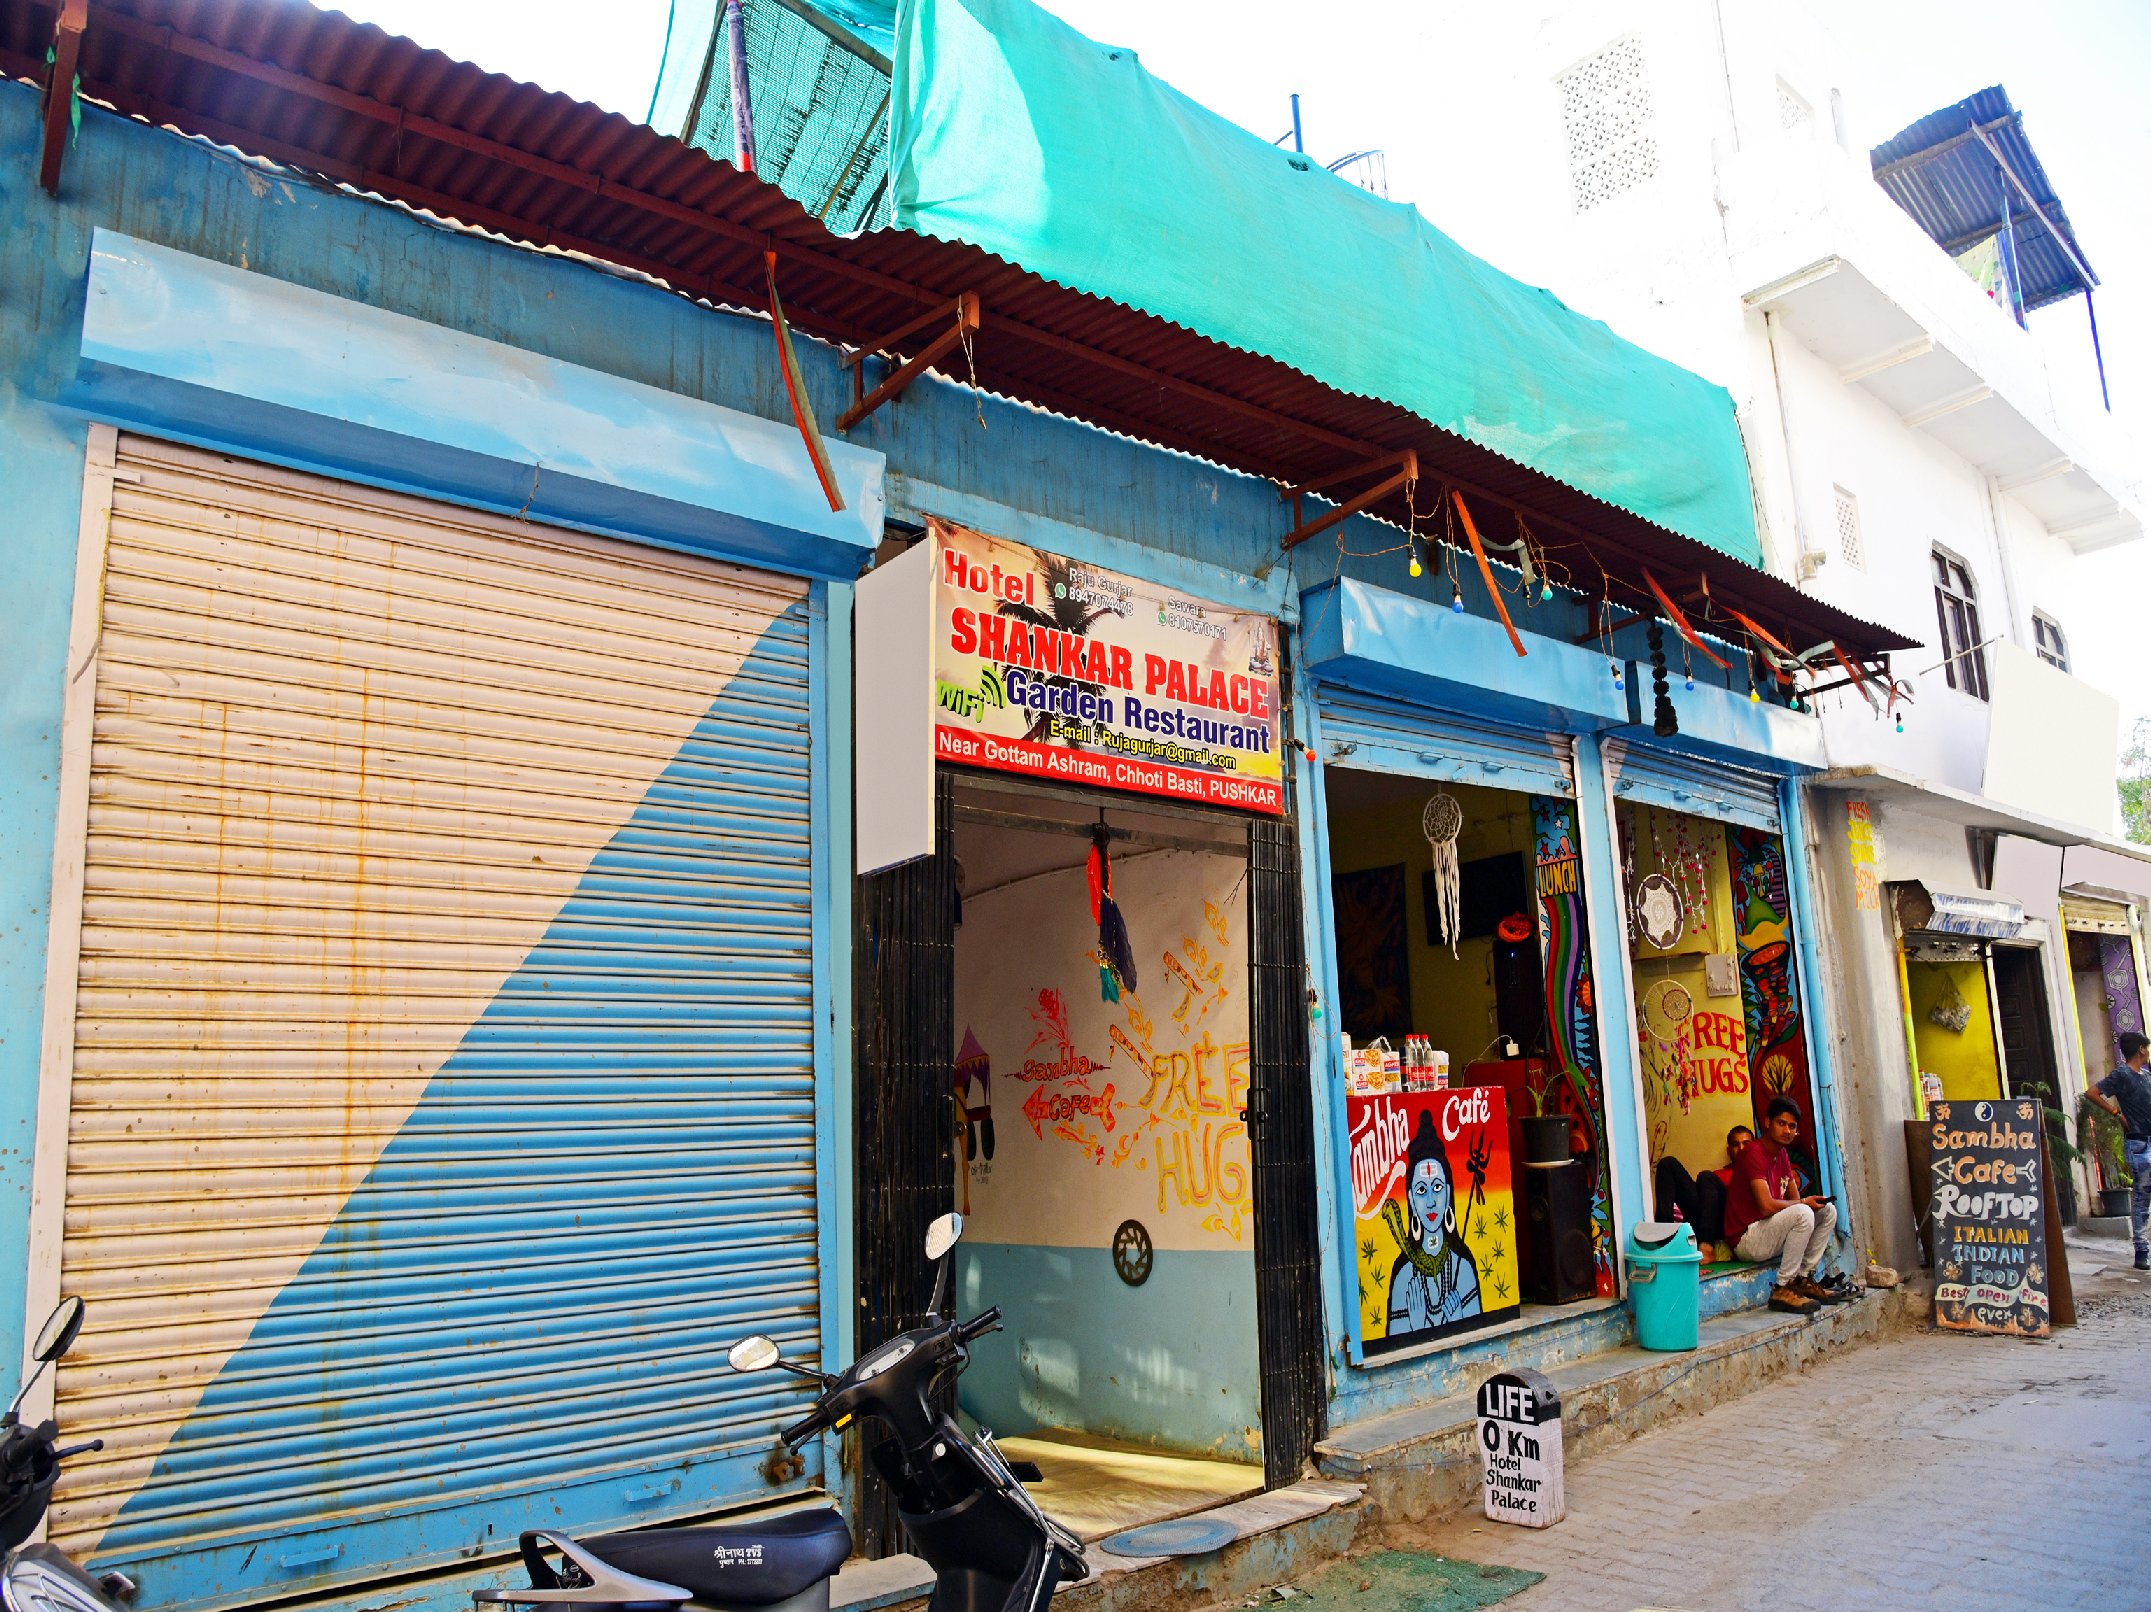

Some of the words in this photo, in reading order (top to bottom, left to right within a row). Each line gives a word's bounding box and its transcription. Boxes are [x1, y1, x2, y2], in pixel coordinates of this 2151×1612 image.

[943, 548, 1034, 606] Hotel
[1069, 567, 1095, 588] Raju
[1098, 576, 1133, 597] Gurjar
[951, 607, 1133, 691] SHANKAR
[1145, 653, 1268, 720] PALACE
[1006, 670, 1113, 724] Garden
[1125, 696, 1270, 754] Restaurant
[1050, 723, 1091, 743] E-mail
[1102, 730, 1237, 770] Rujagurjar@gmail.com
[939, 731, 980, 756] Near
[984, 740, 1044, 768] Gottam
[1047, 752, 1111, 783] Ashram,
[1115, 763, 1163, 789] Chhoti
[1167, 771, 1206, 798] Basti,
[1210, 780, 1277, 807] PUSHKAR
[1538, 859, 1577, 898] LUNCH
[1675, 1011, 1747, 1061] REE
[1138, 1041, 1249, 1118] FREE
[1442, 1087, 1491, 1142] Café
[1932, 1121, 2037, 1150] Sambha
[1954, 1155, 2018, 1185] Cafe
[1953, 1225, 2030, 1245] ITALIAN
[1951, 1244, 2025, 1264] INDIAN
[1971, 1265, 2019, 1286] FOOD
[1941, 1287, 1970, 1299] Best
[1977, 1288, 2010, 1304] open
[1485, 1383, 1535, 1422] LIFE
[1508, 1430, 1541, 1461] Km
[1489, 1453, 1521, 1471] Hotel
[1486, 1468, 1542, 1493] Shankar
[1490, 1489, 1538, 1513] Palace
